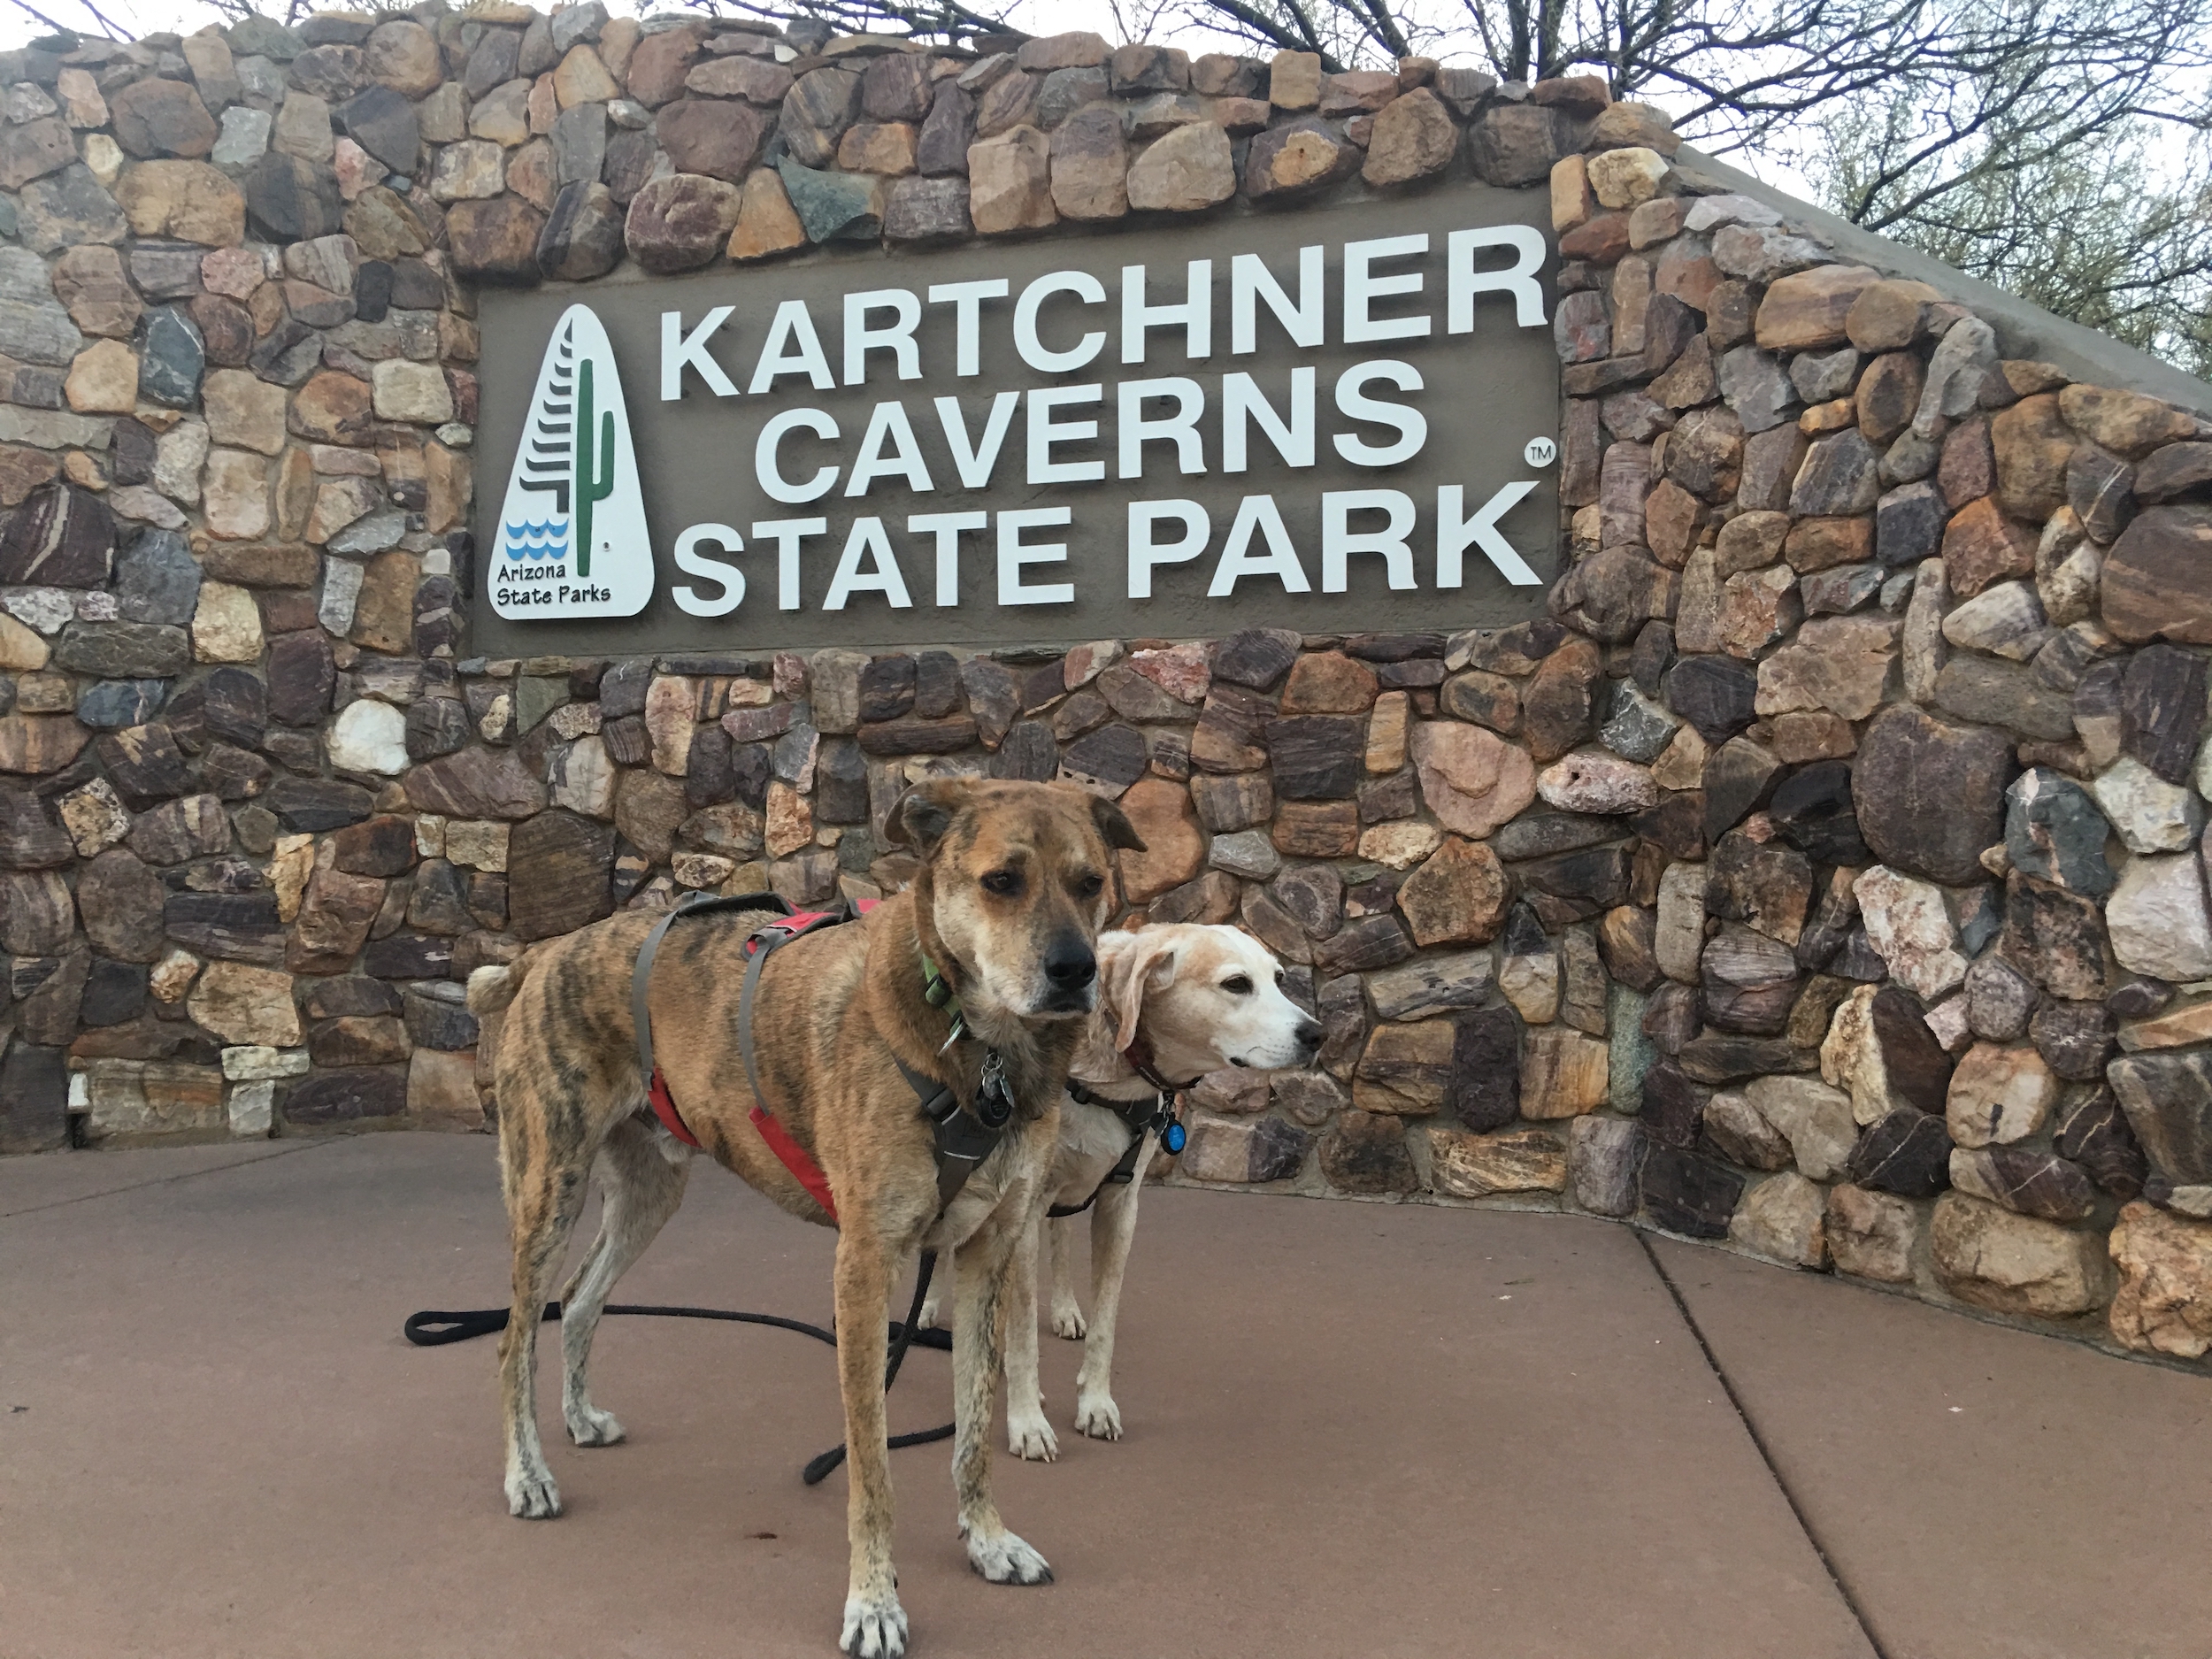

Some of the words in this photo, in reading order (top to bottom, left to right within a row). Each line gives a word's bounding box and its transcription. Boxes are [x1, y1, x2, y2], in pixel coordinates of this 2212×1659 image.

[661, 224, 1548, 401] KARTCHNER
[755, 359, 1428, 503] CAVERNS
[1531, 445, 1551, 460] TM
[497, 564, 566, 583] Arizona
[672, 506, 1075, 618] STATE
[1128, 480, 1543, 599] PARK
[497, 588, 552, 606] State
[558, 583, 611, 603] Parks
